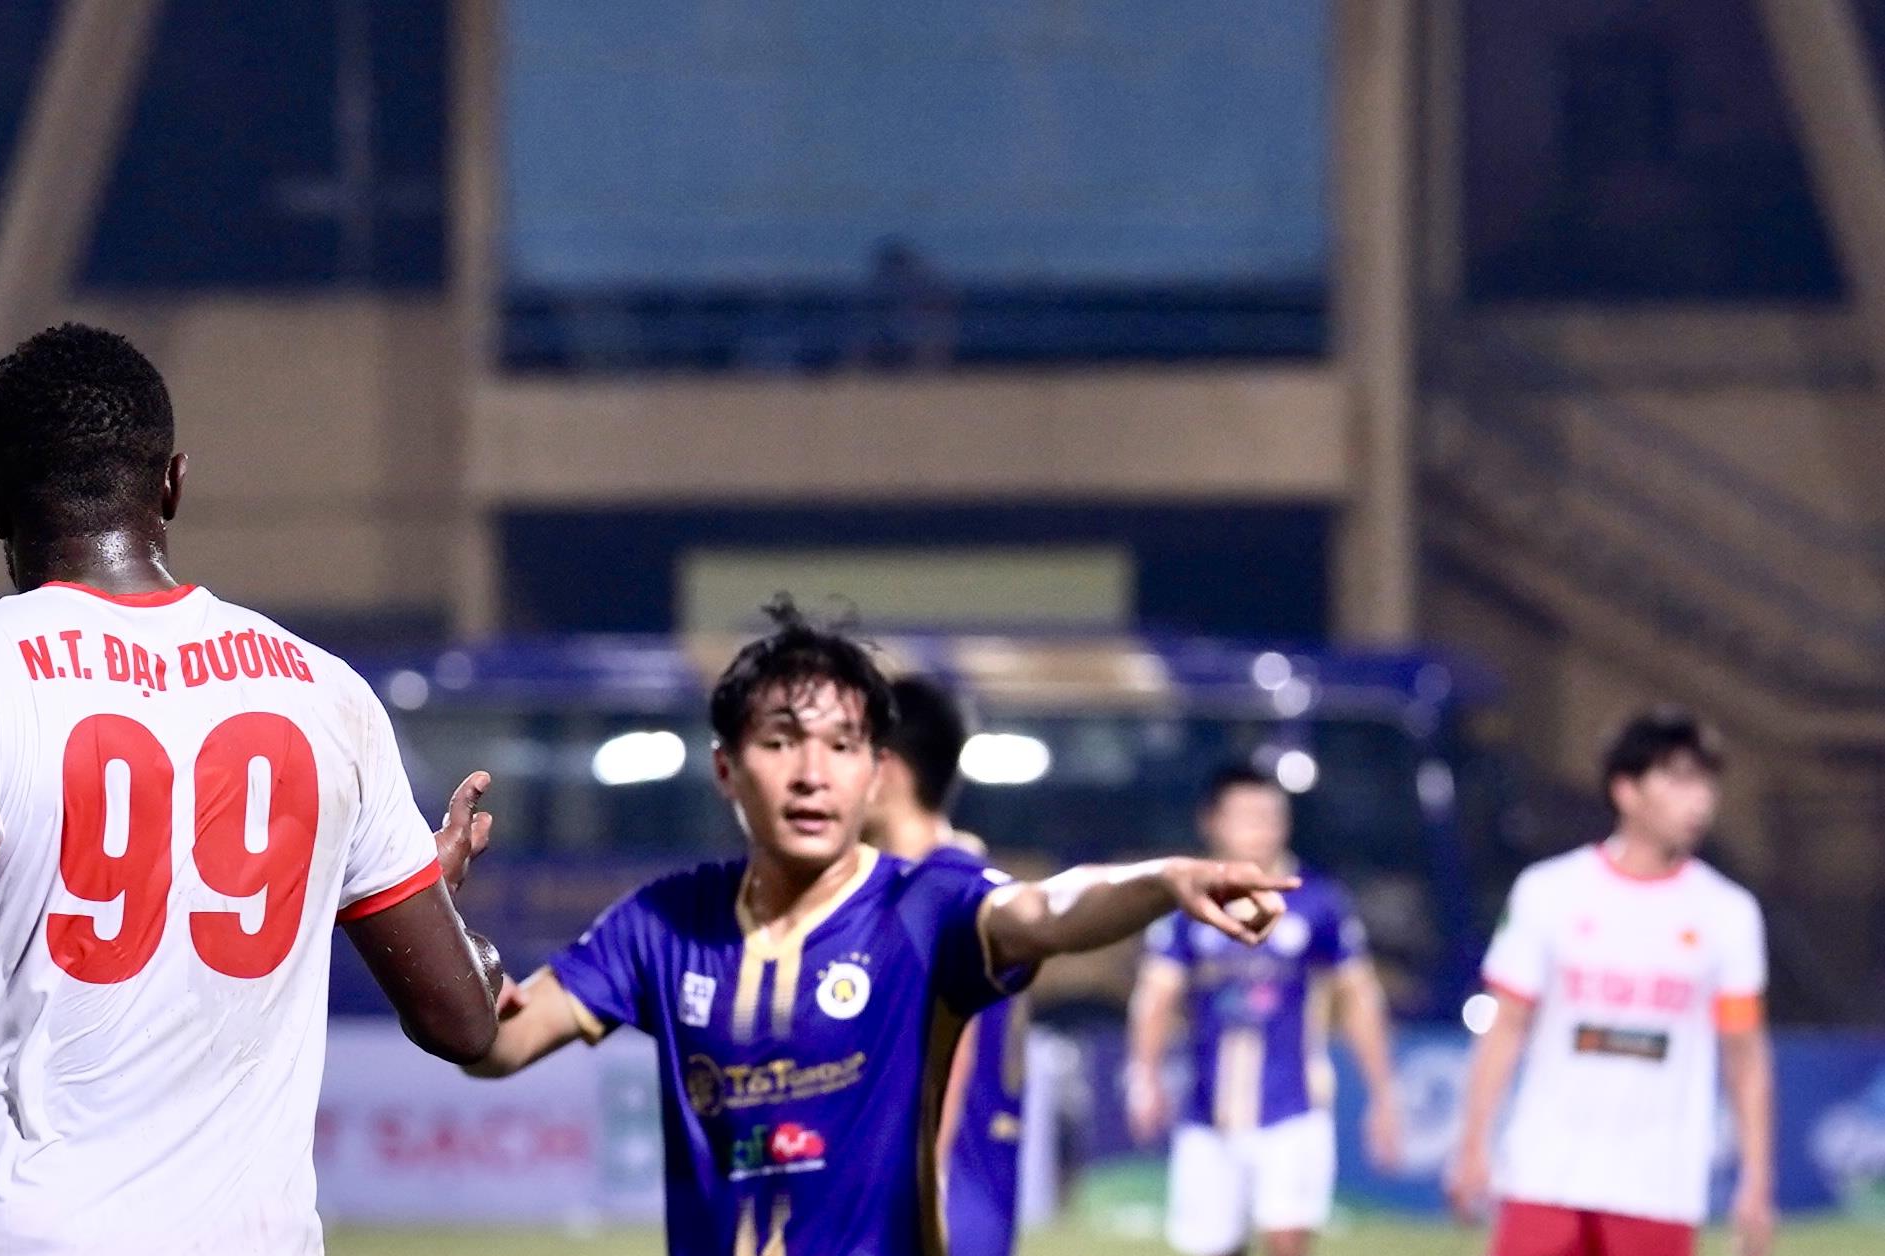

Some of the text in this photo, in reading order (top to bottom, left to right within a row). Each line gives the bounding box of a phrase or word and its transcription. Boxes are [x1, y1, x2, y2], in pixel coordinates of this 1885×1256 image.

[18, 628, 315, 698] N.T. ĐẠI DƯƠNG
[47, 712, 319, 985] 99
